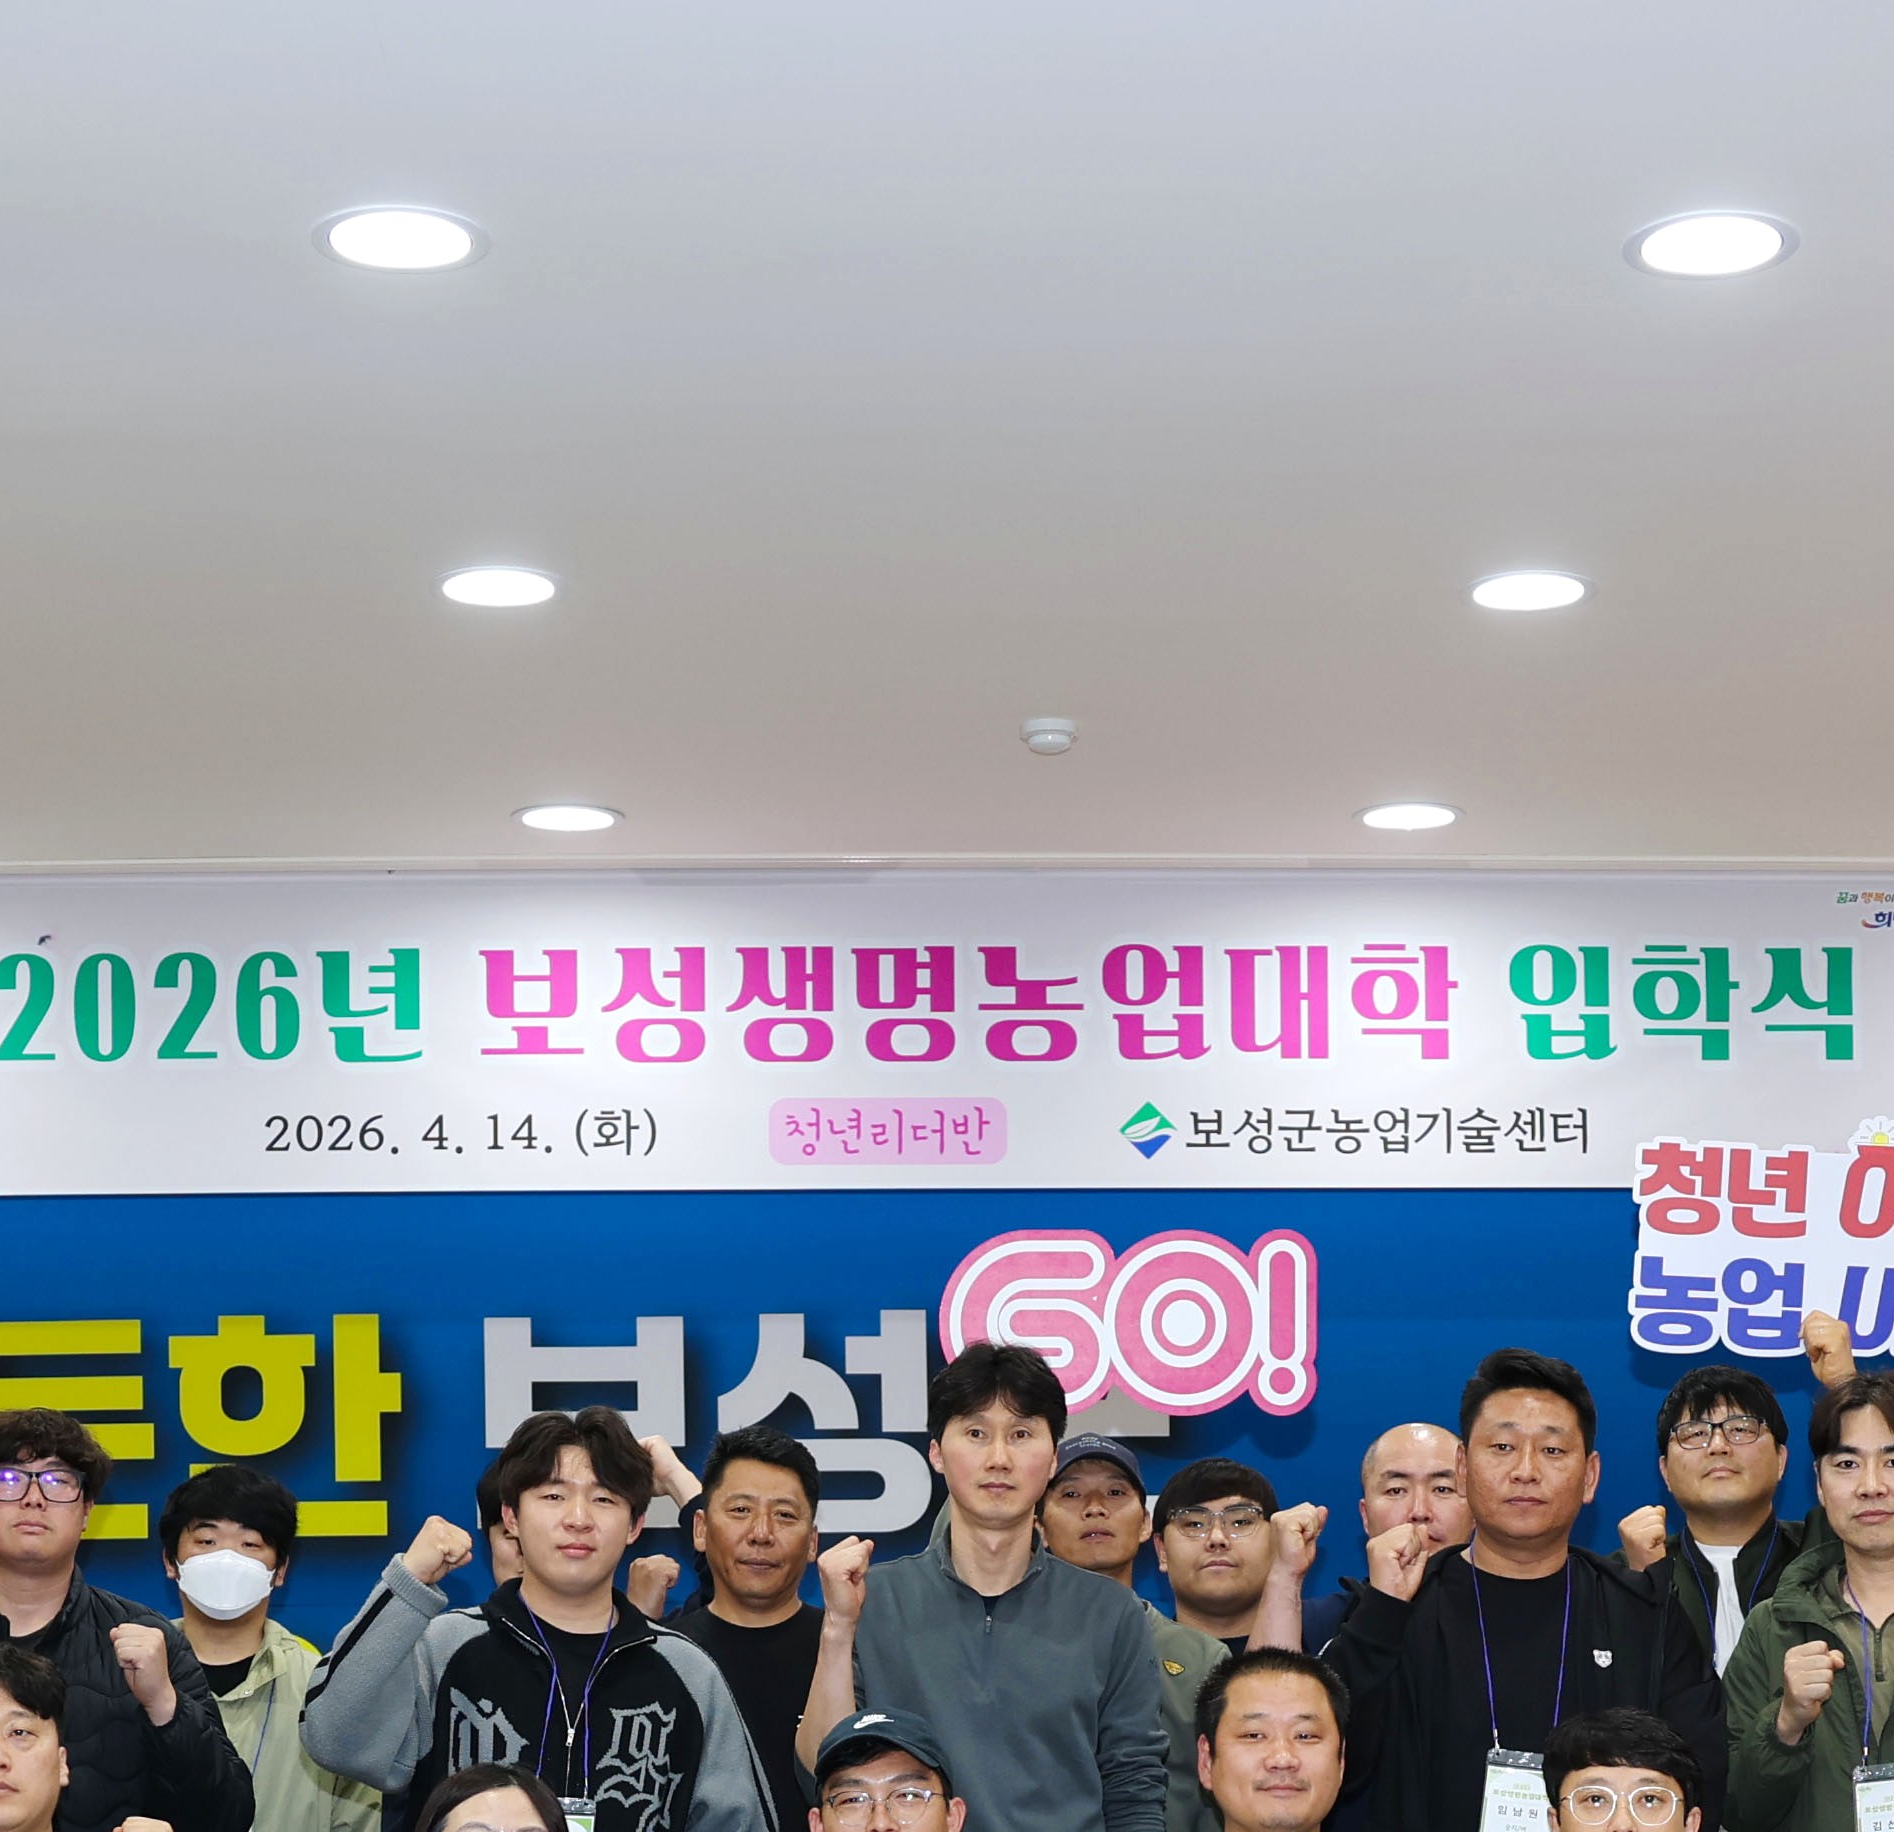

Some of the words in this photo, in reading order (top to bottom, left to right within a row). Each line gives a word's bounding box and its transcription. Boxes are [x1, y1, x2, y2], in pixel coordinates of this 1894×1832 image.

[1836, 891, 1859, 904] 꿈과
[1860, 892, 1894, 904] 행복이
[478, 943, 1460, 1064] 보성생명농업대학
[1507, 943, 1855, 1062] 입학식
[264, 1113, 401, 1156] 2026.
[421, 1113, 465, 1156] 4.
[484, 1113, 554, 1156] 14.
[574, 1107, 659, 1158] (화)
[783, 1104, 991, 1158] 청년리더반
[1185, 1106, 1589, 1156] 보성군농업기술센터
[1638, 1143, 1808, 1239] 청년
[946, 1238, 1308, 1408] GO!
[1636, 1254, 1806, 1342] 농업
